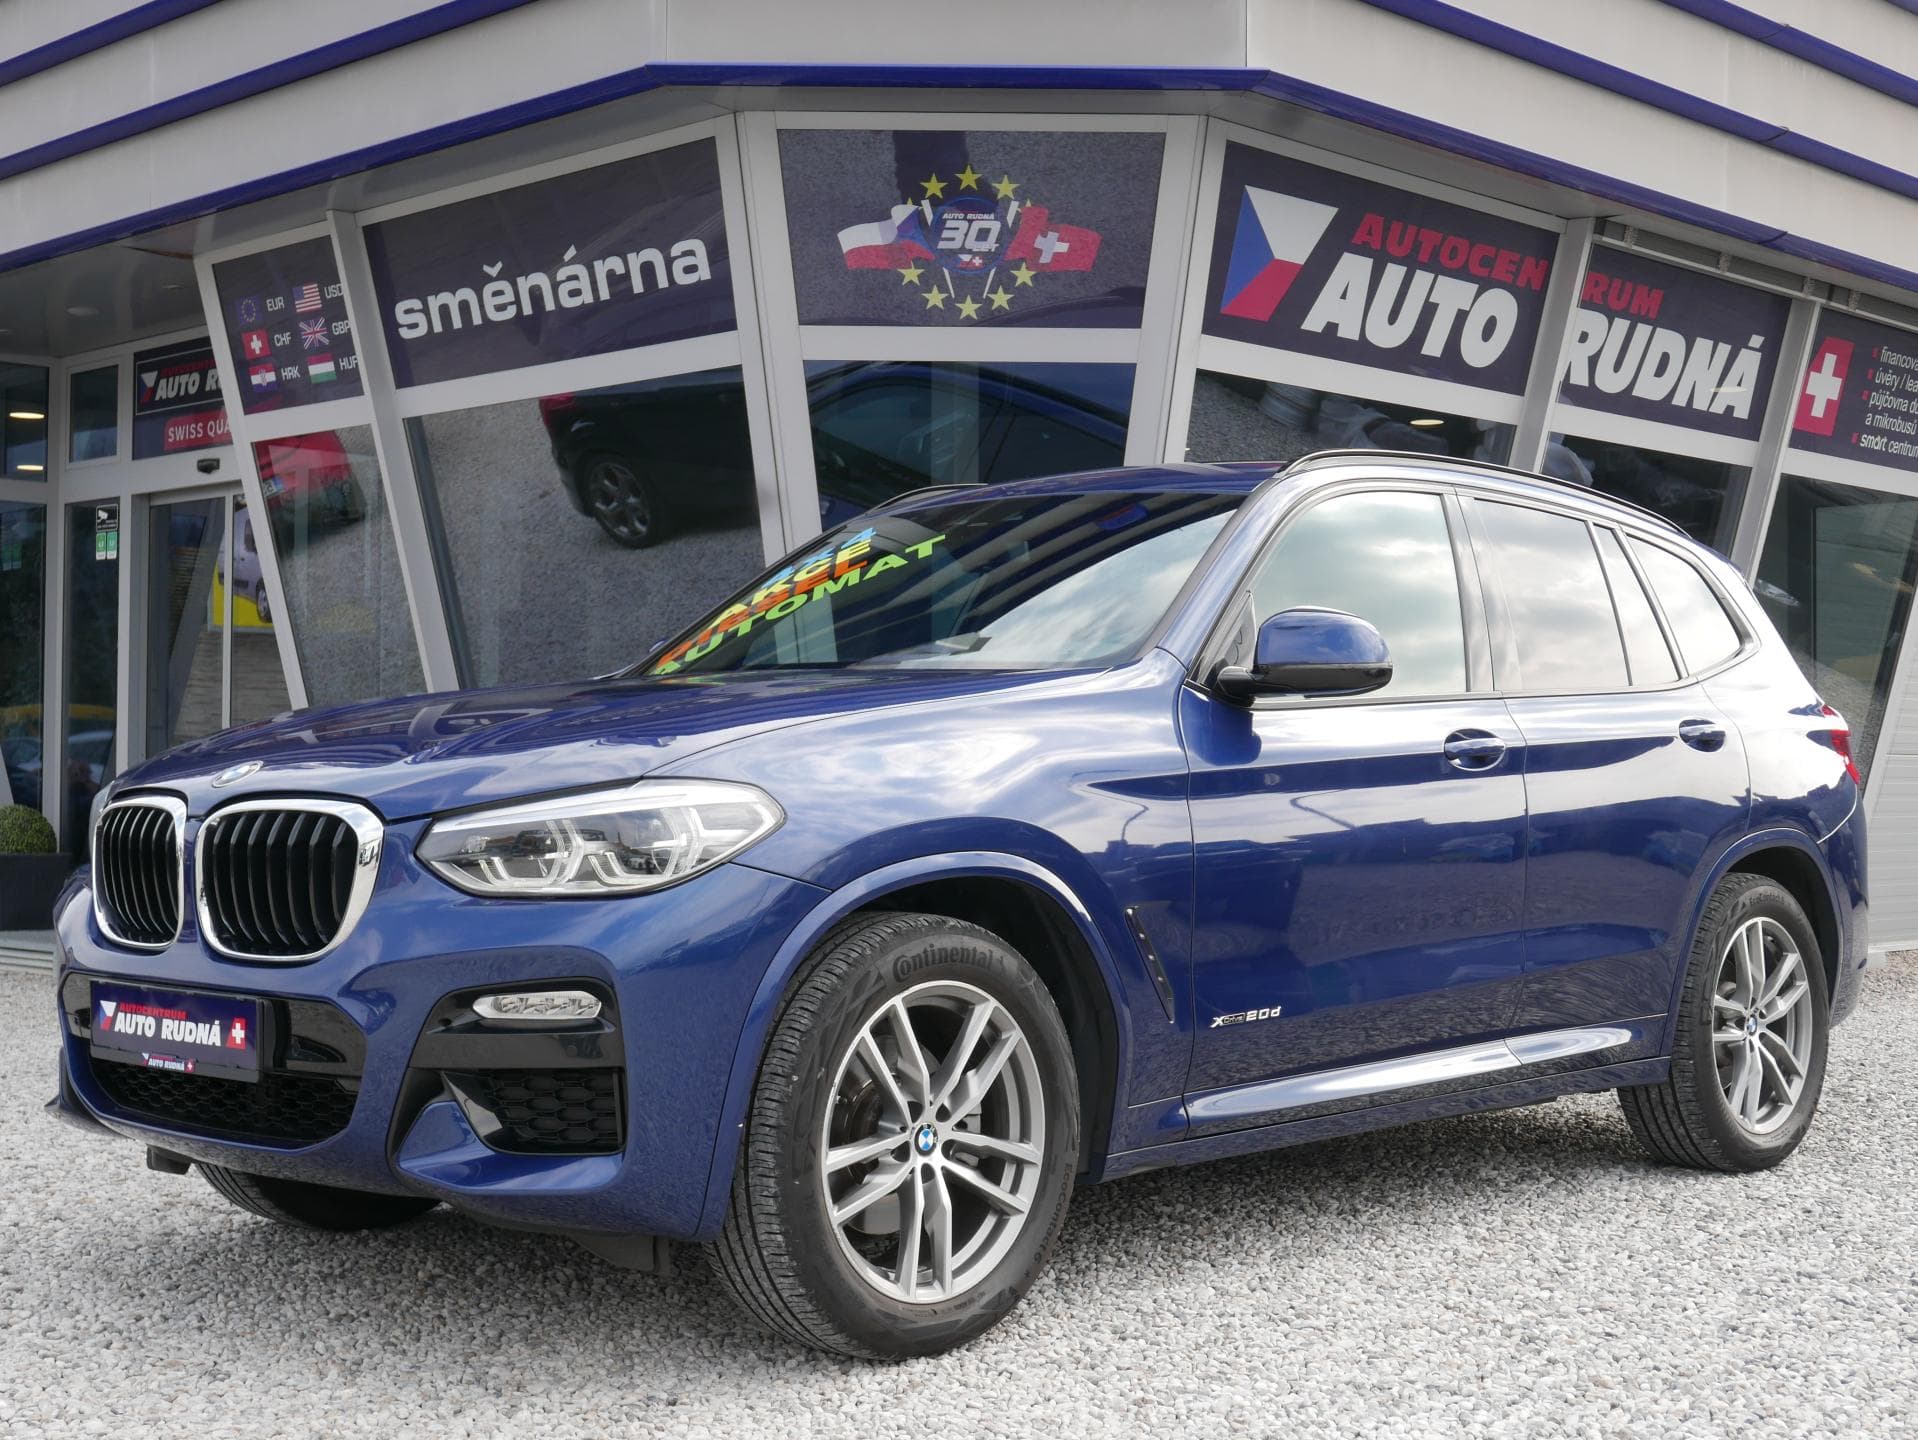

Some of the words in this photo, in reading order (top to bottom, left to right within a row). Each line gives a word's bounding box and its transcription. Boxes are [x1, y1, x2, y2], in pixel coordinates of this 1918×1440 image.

[936, 220, 1002, 249] 30
[324, 283, 344, 299] USD
[394, 237, 712, 340] směnárna
[266, 297, 285, 312] EUR
[274, 332, 292, 347] CHF
[332, 320, 350, 335] GBP
[1301, 251, 1518, 368] AUTO
[1560, 307, 1765, 420] RUDNÁ
[281, 366, 300, 381] HRK
[339, 355, 359, 371] HUF
[154, 372, 201, 401] AUTO
[1875, 367, 1900, 391] úvěry
[167, 422, 204, 442] SWISS
[1865, 413, 1873, 425] a
[707, 538, 872, 630] AKCE
[652, 534, 946, 675] AUTOMAT
[656, 560, 868, 669] DIESEL
[893, 943, 993, 983] Continental
[114, 1012, 156, 1037] AUTO
[161, 1019, 221, 1046] RUDNÁ
